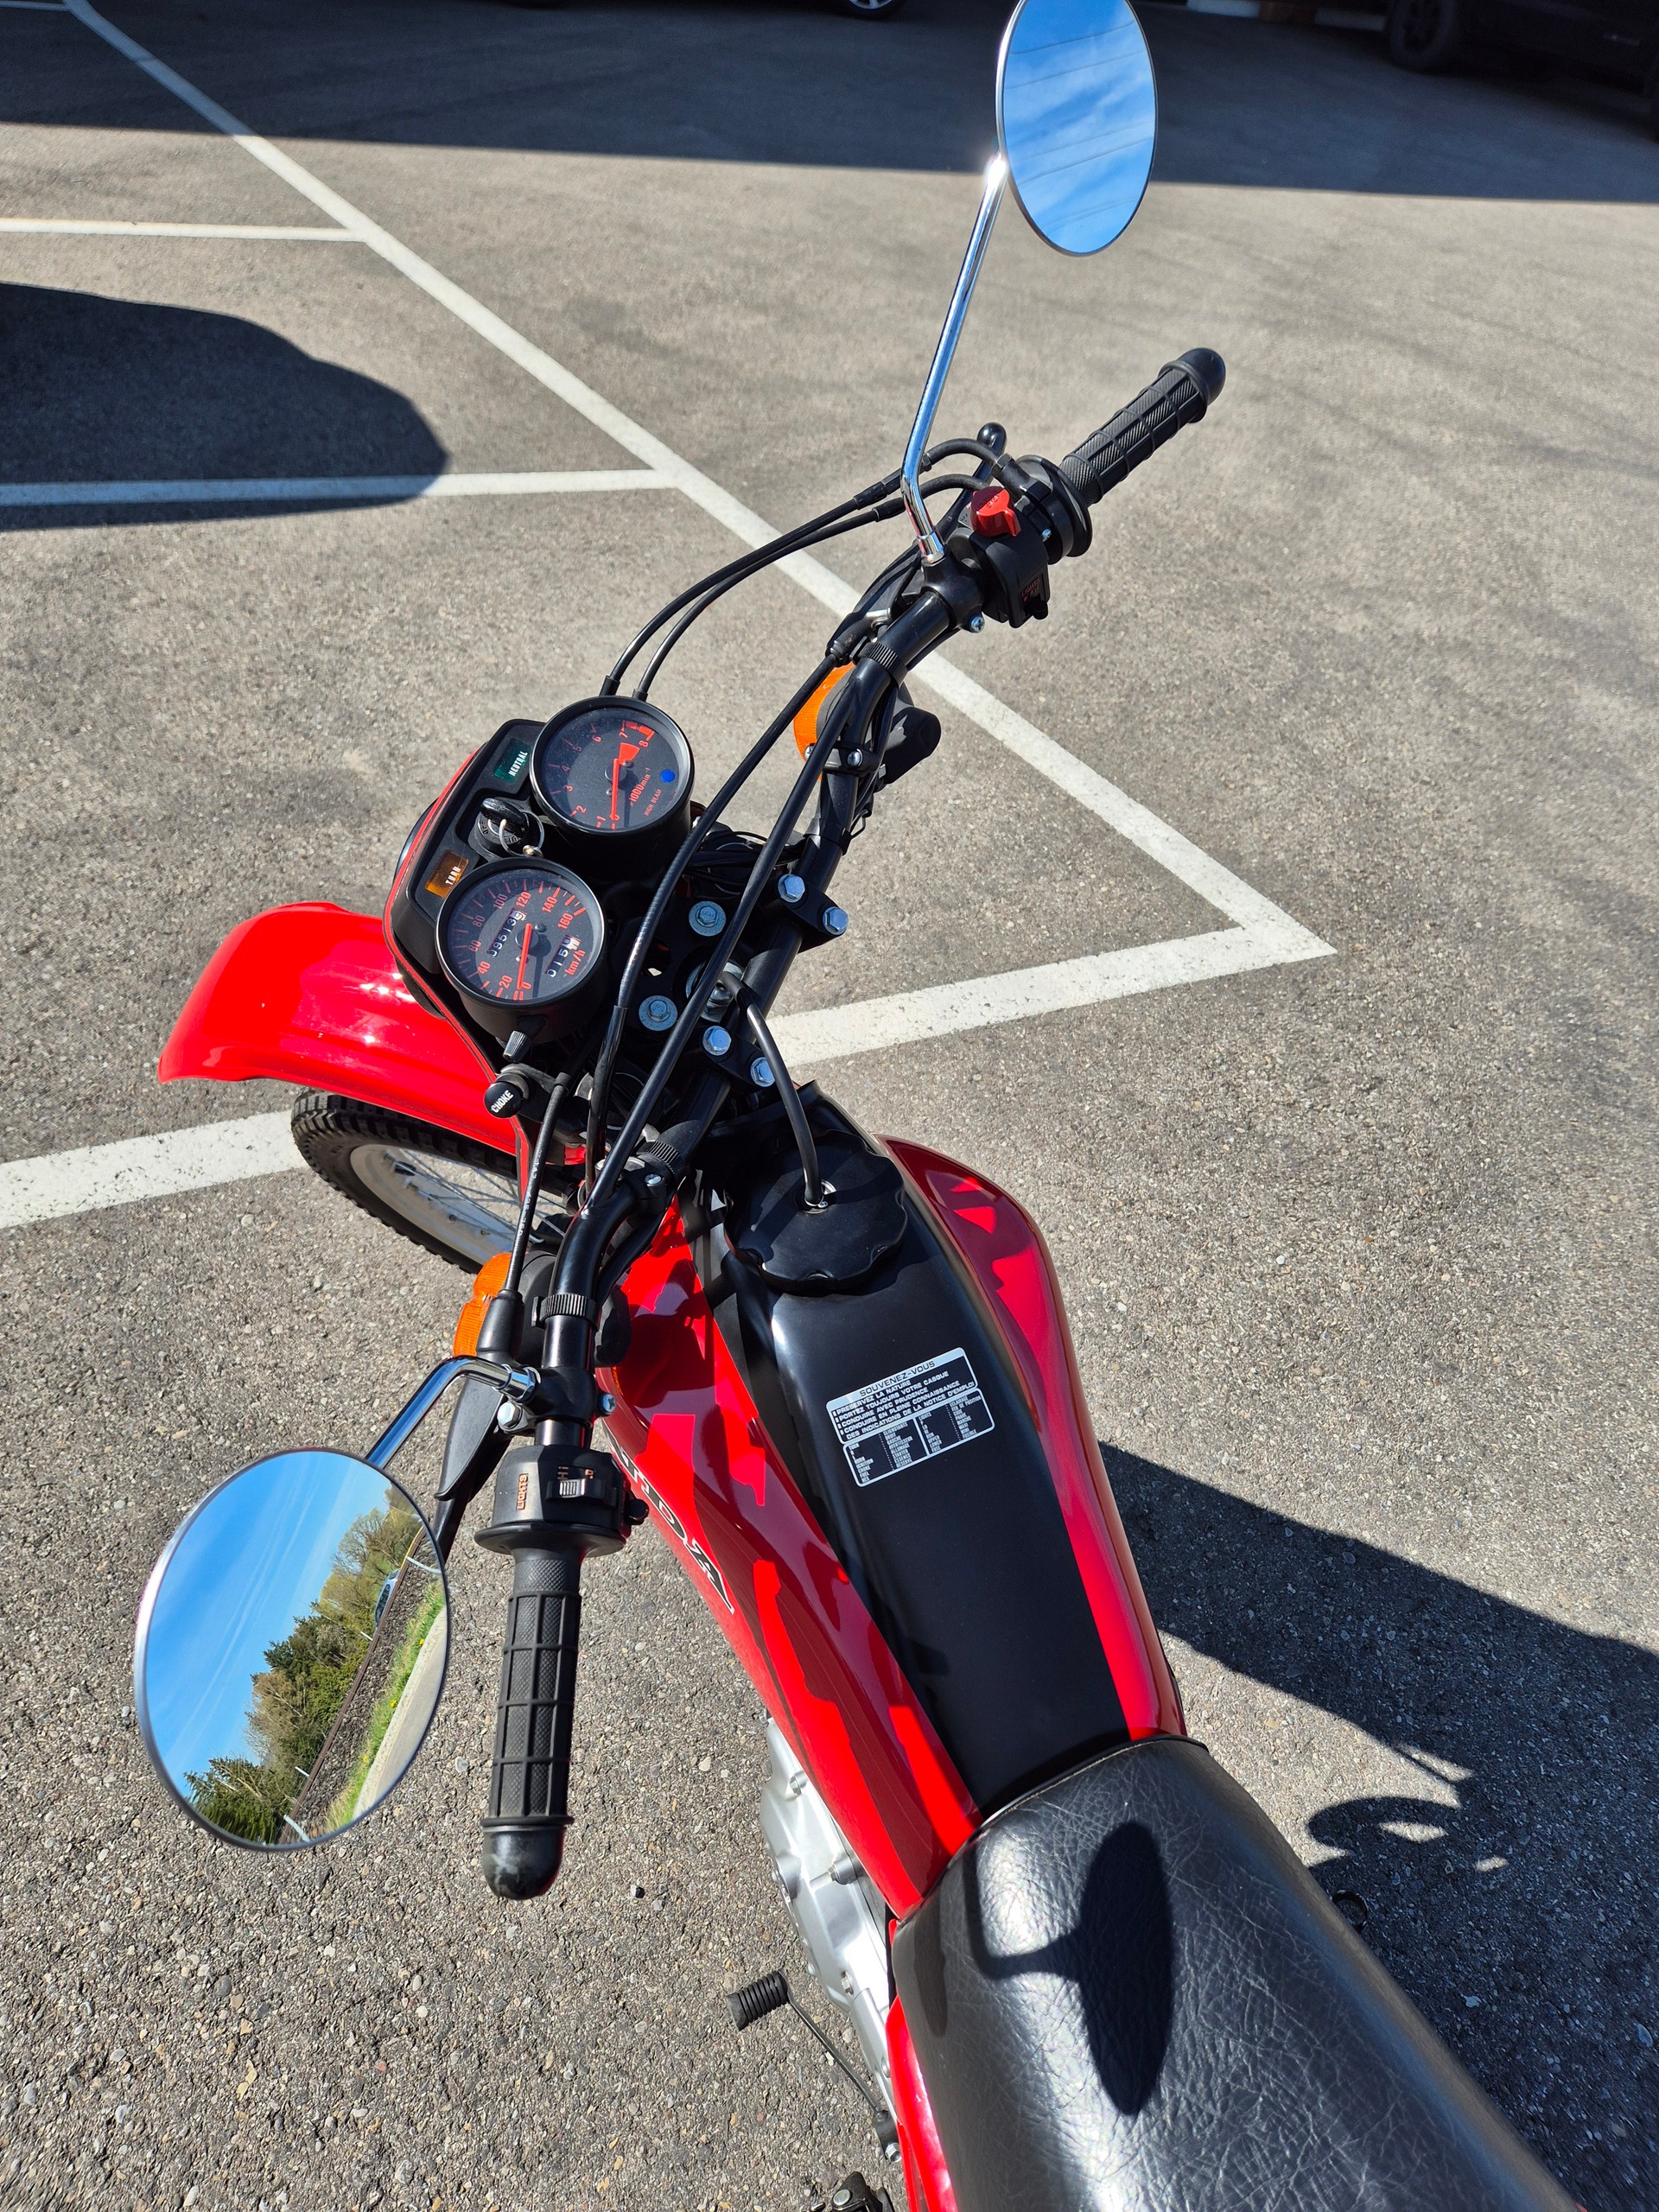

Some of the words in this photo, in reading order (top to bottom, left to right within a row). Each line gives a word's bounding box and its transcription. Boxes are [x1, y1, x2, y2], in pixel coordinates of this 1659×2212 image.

[638, 740, 649, 748] 8
[508, 751, 528, 777] NEUTRAL
[651, 789, 663, 804] BEAM
[575, 804, 587, 814] 2
[445, 866, 461, 886] TURN
[493, 893, 508, 910] 100
[515, 891, 531, 907] 120
[542, 895, 557, 912] 140
[473, 915, 486, 928] 80
[557, 912, 574, 930] 160
[467, 940, 481, 952] 60
[477, 961, 491, 975] 40
[564, 950, 586, 976] km/h
[499, 975, 512, 989] 20
[490, 1090, 514, 1113] CHOKE
[859, 1360, 935, 1397] SOUVENEZ-VOUS
[885, 1379, 911, 1394] NATURE
[838, 1406, 864, 1421] PORTEZ
[865, 1391, 899, 1410] TOUJOURS
[901, 1382, 922, 1395] VOTRE
[923, 1370, 949, 1386] CASQUE
[841, 1409, 874, 1427] CONDUIRE
[875, 1401, 893, 1413] AVEC
[894, 1386, 928, 1405] PRUDENCE
[843, 1415, 877, 1433] CONDUIRE
[888, 1401, 911, 1414] PLEINE
[912, 1380, 960, 1405] CONNAISSANCE
[846, 1429, 861, 1440] DES
[861, 1412, 901, 1433] INDICATIONS
[901, 1408, 912, 1416] DE
[912, 1403, 922, 1412] LA
[923, 1393, 946, 1408] NOTICE
[517, 1473, 529, 1511] LIGHTS
